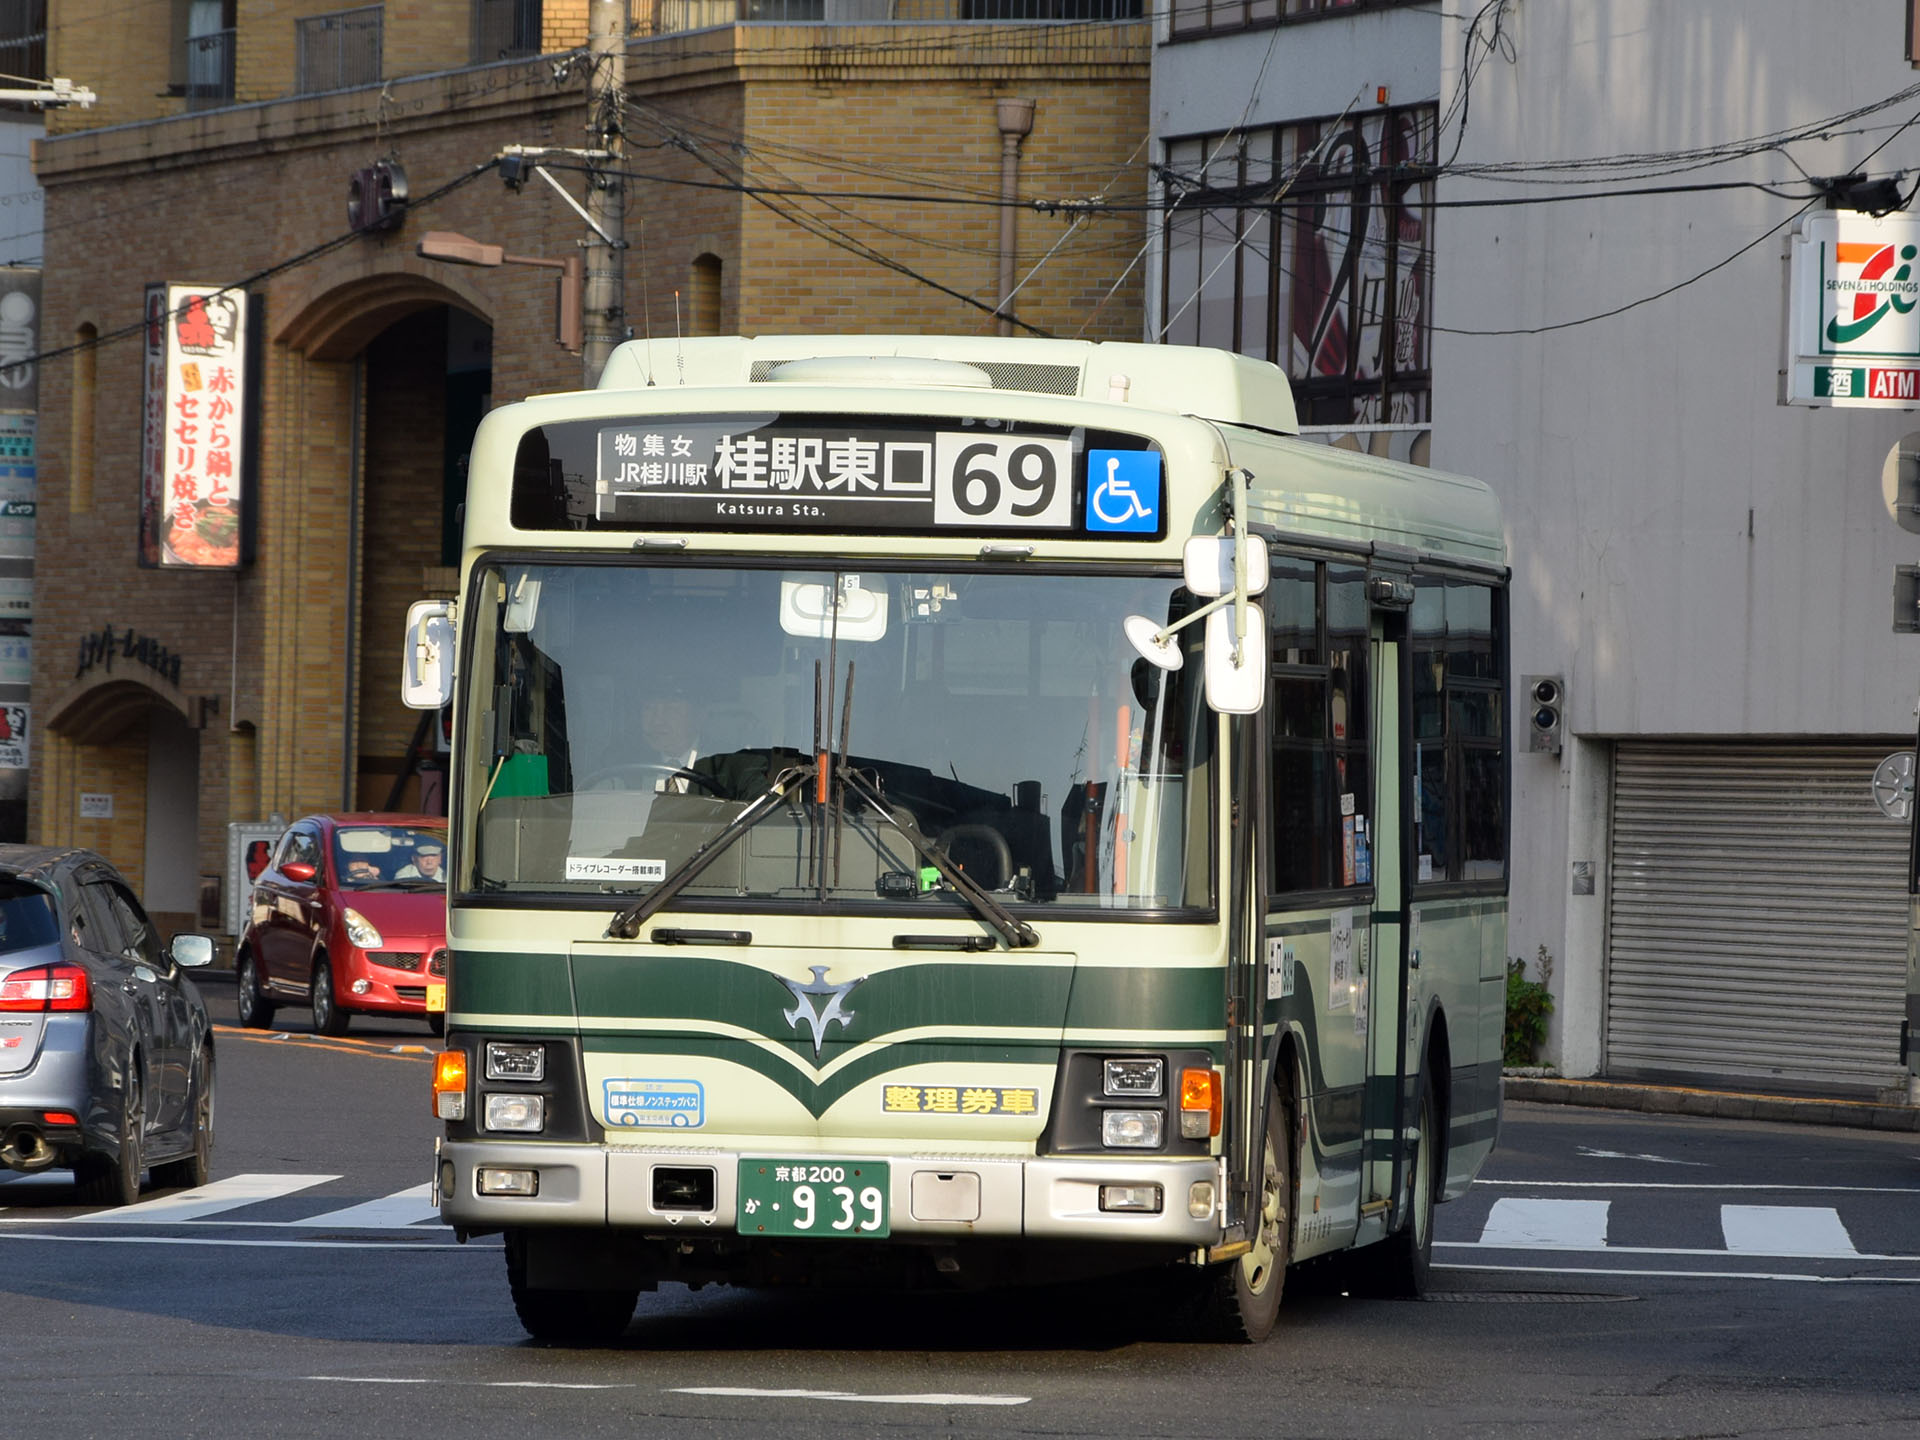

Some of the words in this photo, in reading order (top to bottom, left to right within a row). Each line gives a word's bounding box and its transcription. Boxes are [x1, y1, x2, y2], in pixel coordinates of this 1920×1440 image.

[1869, 281, 1918, 293] HOLDINGS
[1827, 368, 1853, 397] 酒
[1873, 370, 1915, 398] ATM
[206, 365, 235, 507] 赤から鍋と
[614, 433, 694, 458] 物集女
[172, 393, 199, 529] セセリ焼き
[614, 462, 708, 486] JR桂川駅
[714, 434, 932, 492] 桂駅東口
[951, 442, 1058, 517] 69
[716, 502, 784, 517] Katsura
[792, 504, 826, 517] Sta.
[569, 863, 662, 876] ドライブレコーダー搭載車両
[884, 1085, 1036, 1115] 整理券車
